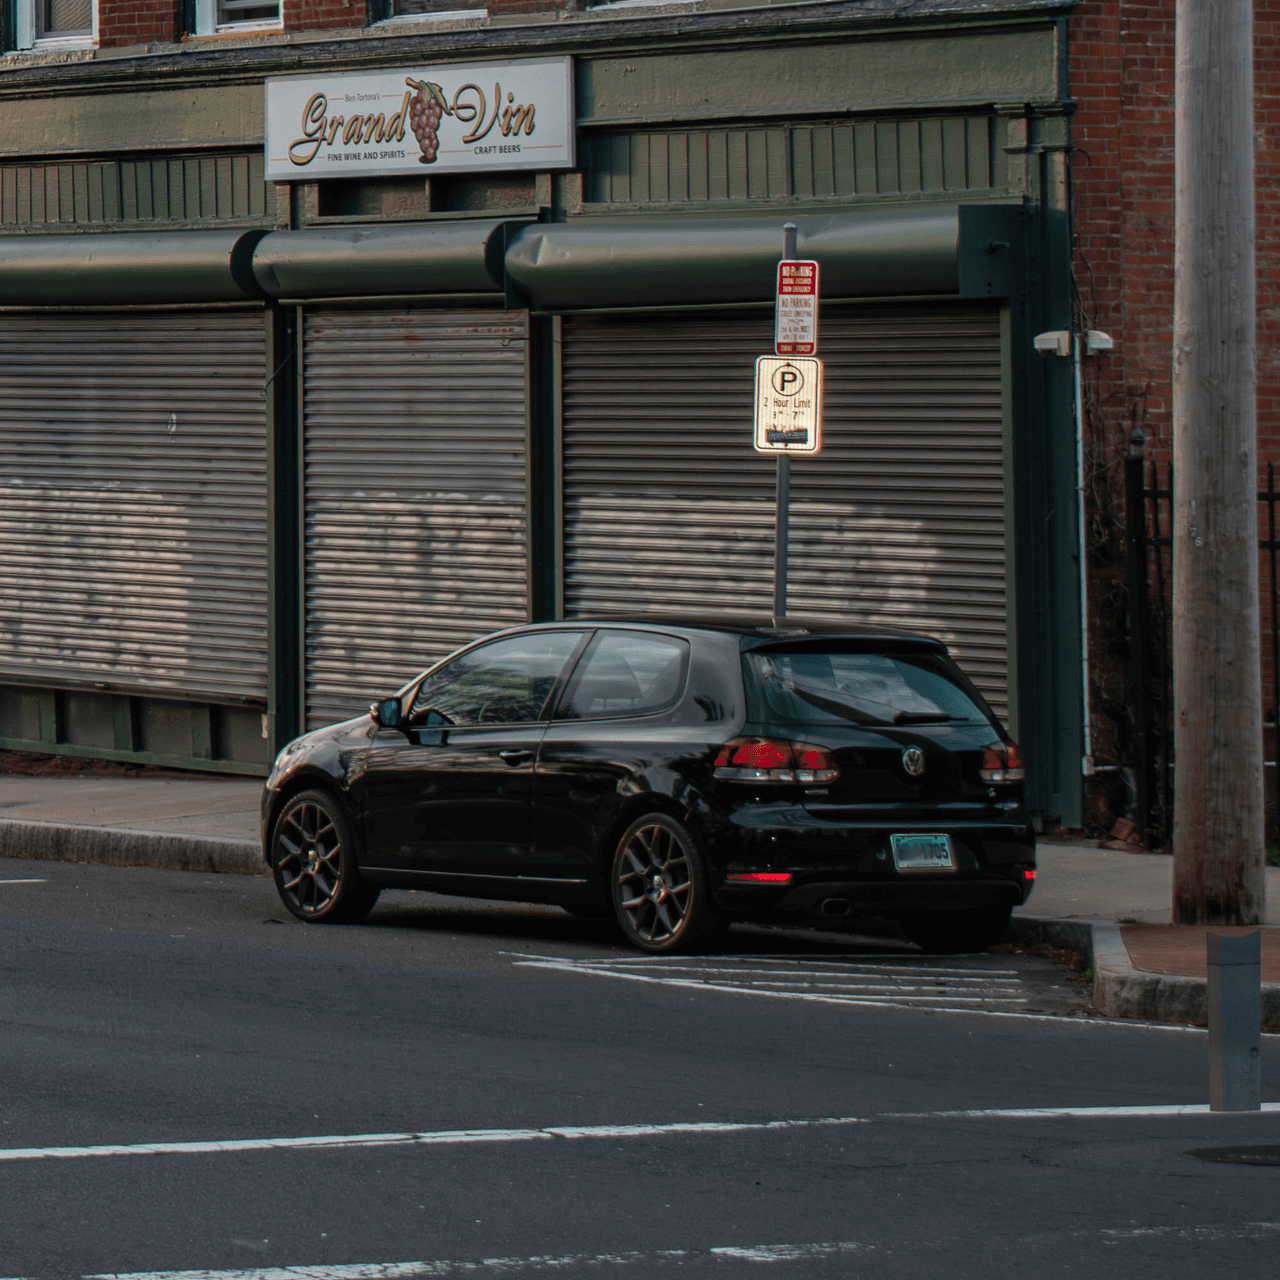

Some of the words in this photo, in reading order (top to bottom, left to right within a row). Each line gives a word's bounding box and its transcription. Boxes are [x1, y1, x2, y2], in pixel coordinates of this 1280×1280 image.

[345, 94, 356, 102] Ben
[288, 91, 411, 166] Grand
[449, 82, 535, 144] Vin
[474, 145, 497, 155] CRAFT
[499, 144, 521, 154] BEERS
[327, 153, 342, 161] FINE
[344, 152, 361, 161] WINE
[363, 152, 378, 160] AND
[379, 150, 405, 159] SPIRITS
[790, 297, 812, 308] PARKING
[780, 371, 797, 391] P
[763, 397, 769, 407] 2
[773, 398, 789, 408] Hour
[793, 398, 811, 408] Limit
